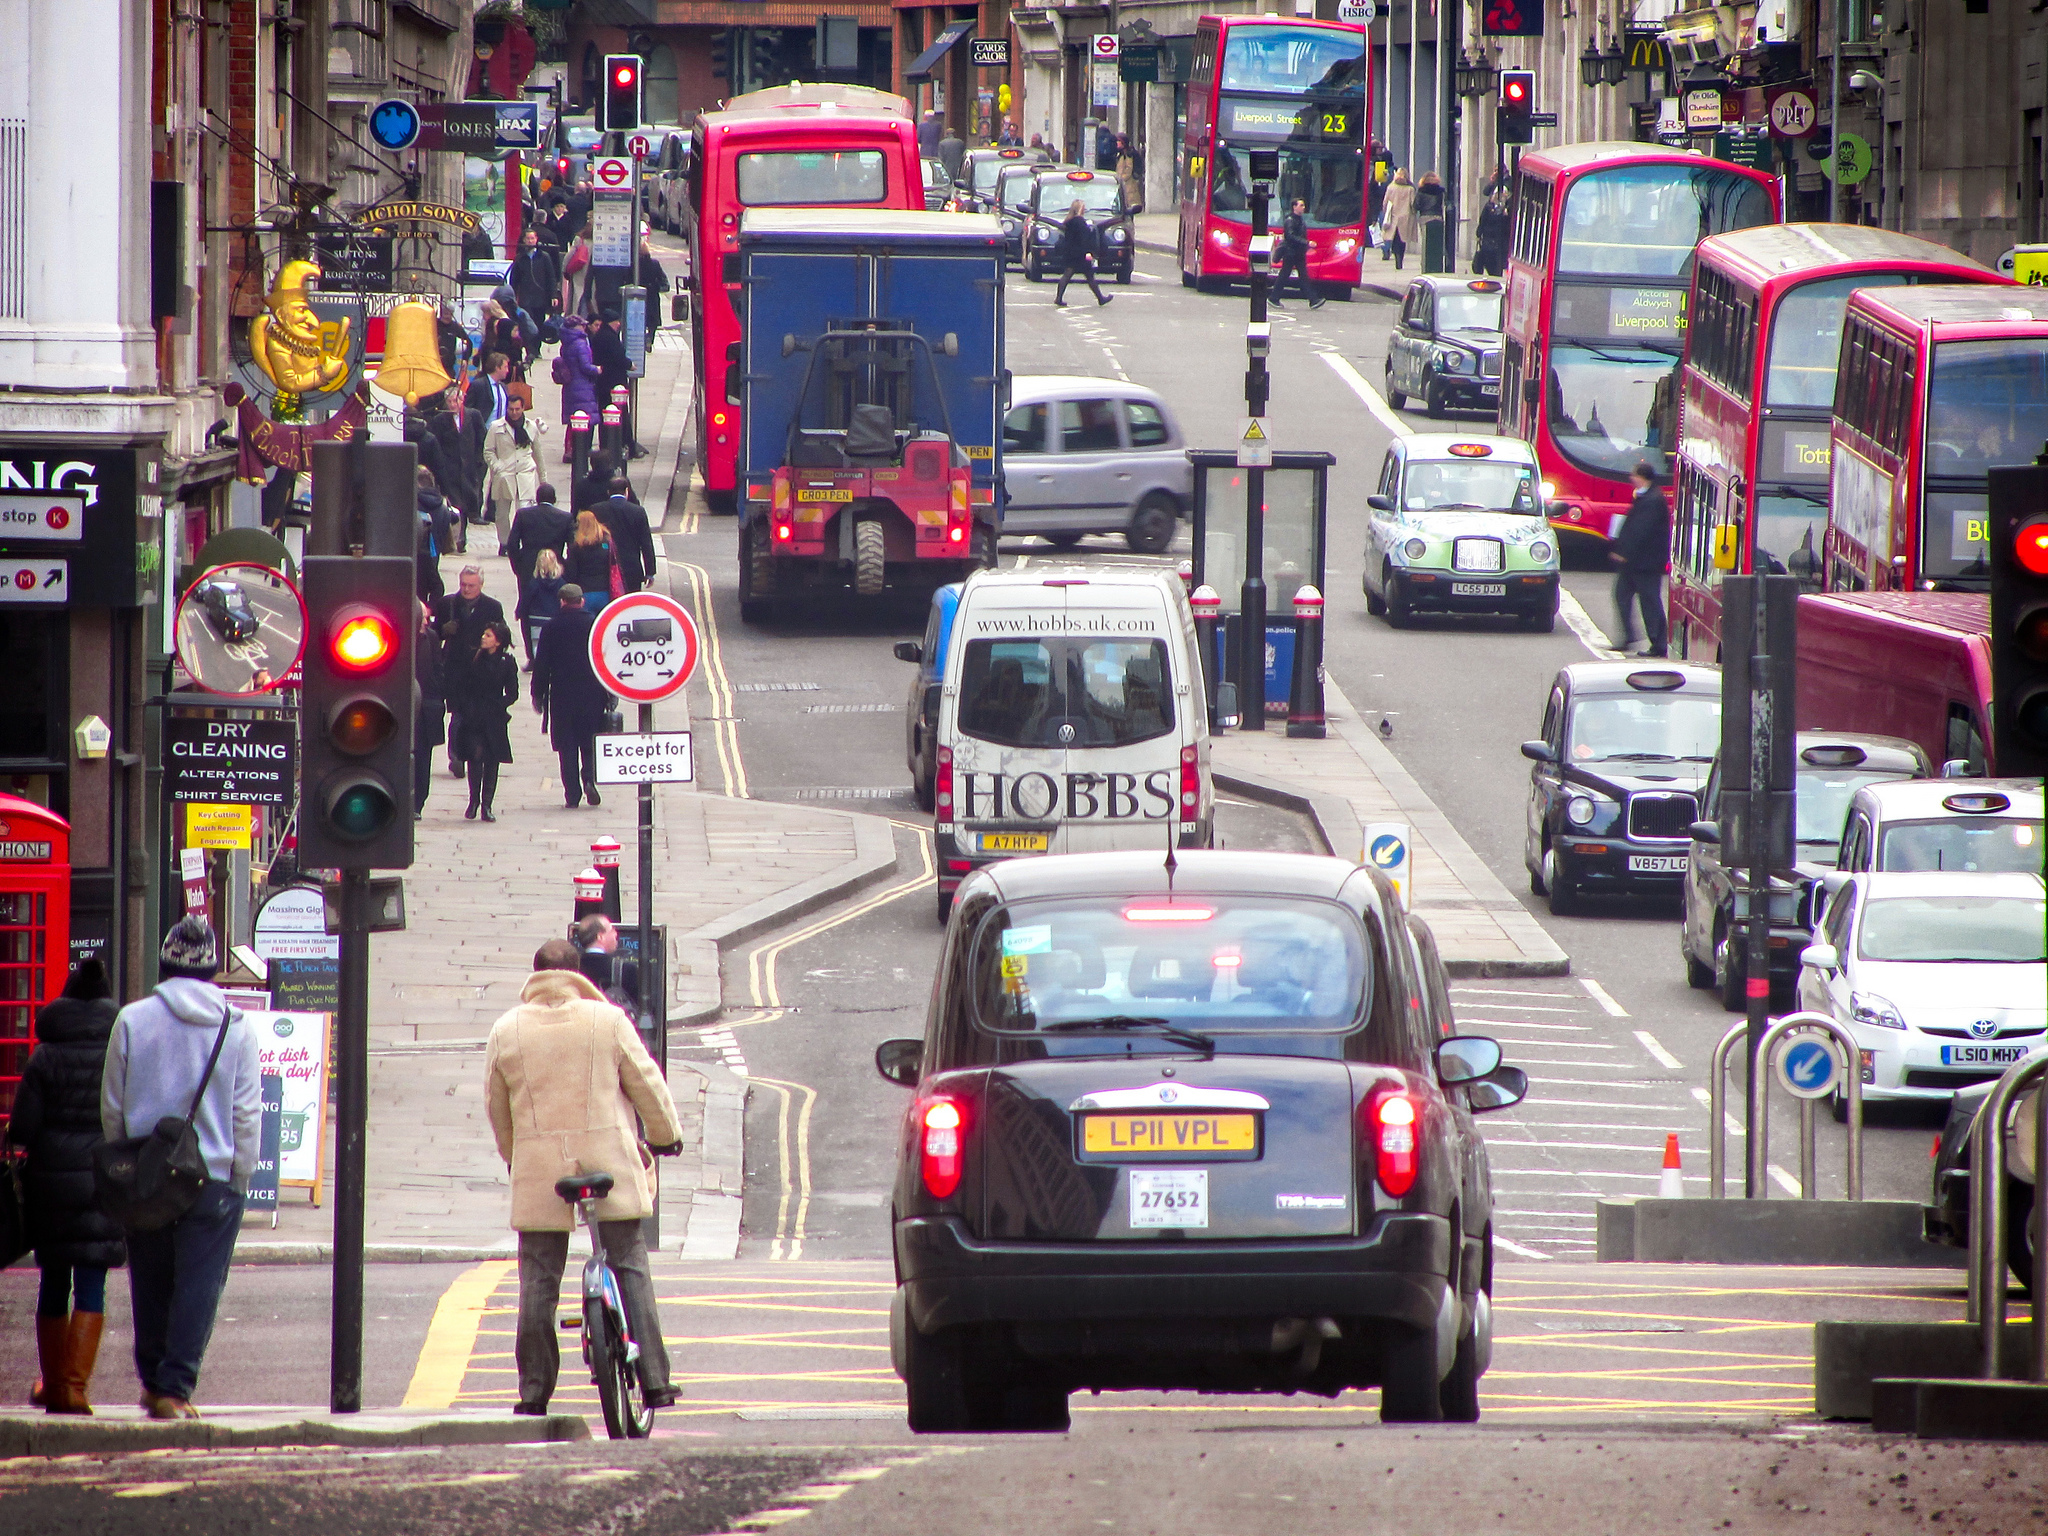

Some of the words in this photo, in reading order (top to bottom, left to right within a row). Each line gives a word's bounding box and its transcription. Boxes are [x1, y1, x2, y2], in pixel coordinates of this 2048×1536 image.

[1343, 8, 1373, 17] HSBC
[976, 43, 1006, 52] CARDS
[974, 52, 1007, 60] GALORE
[1692, 115, 1718, 123] Cheese
[1778, 104, 1807, 124] PRET
[1235, 112, 1274, 124] Liverpool
[1276, 114, 1302, 125] Street
[1322, 114, 1346, 133] 23
[356, 203, 475, 229] NICHOLSON'S
[351, 261, 358, 269] &
[1638, 289, 1669, 298] Victoria
[1633, 297, 1672, 309] Aldwych
[1615, 313, 1668, 331] Liverpool
[251, 420, 300, 471] Punch
[970, 446, 989, 457] PEN
[830, 490, 849, 500] PEN
[2, 509, 37, 525] stop
[52, 512, 62, 524] K
[1456, 584, 1481, 593] LC55
[1483, 584, 1502, 593] DJX
[976, 615, 1155, 632] www.hobbs.uk.com
[207, 722, 251, 737] DRY
[172, 741, 287, 759] CLEANING
[603, 743, 661, 759] Except
[665, 742, 685, 755] for
[178, 770, 279, 780] ALTERATIONS
[618, 762, 673, 776] access
[223, 781, 235, 789] &
[174, 791, 217, 800] SHIRT
[221, 792, 283, 801] SERVICE
[960, 771, 1175, 819] HOBBS
[198, 811, 212, 820] Key
[213, 811, 241, 820] Cutting
[217, 825, 245, 833] Repairs
[200, 838, 237, 846] Engraving
[993, 837, 1010, 849] A7
[1012, 837, 1038, 849] HTP
[1634, 858, 1667, 870] V857
[267, 905, 304, 914] Massimo
[70, 939, 89, 948] SAME
[91, 938, 105, 947] DAY
[80, 950, 94, 959] DRY
[274, 1023, 293, 1034] pod
[258, 1049, 274, 1062] ot
[279, 1047, 310, 1063] dish
[1992, 1048, 2021, 1062] MHX
[286, 1062, 320, 1082] day!
[1110, 1120, 1164, 1146] LP11
[1174, 1119, 1229, 1146] VPL
[1140, 1190, 1199, 1208] 27652
